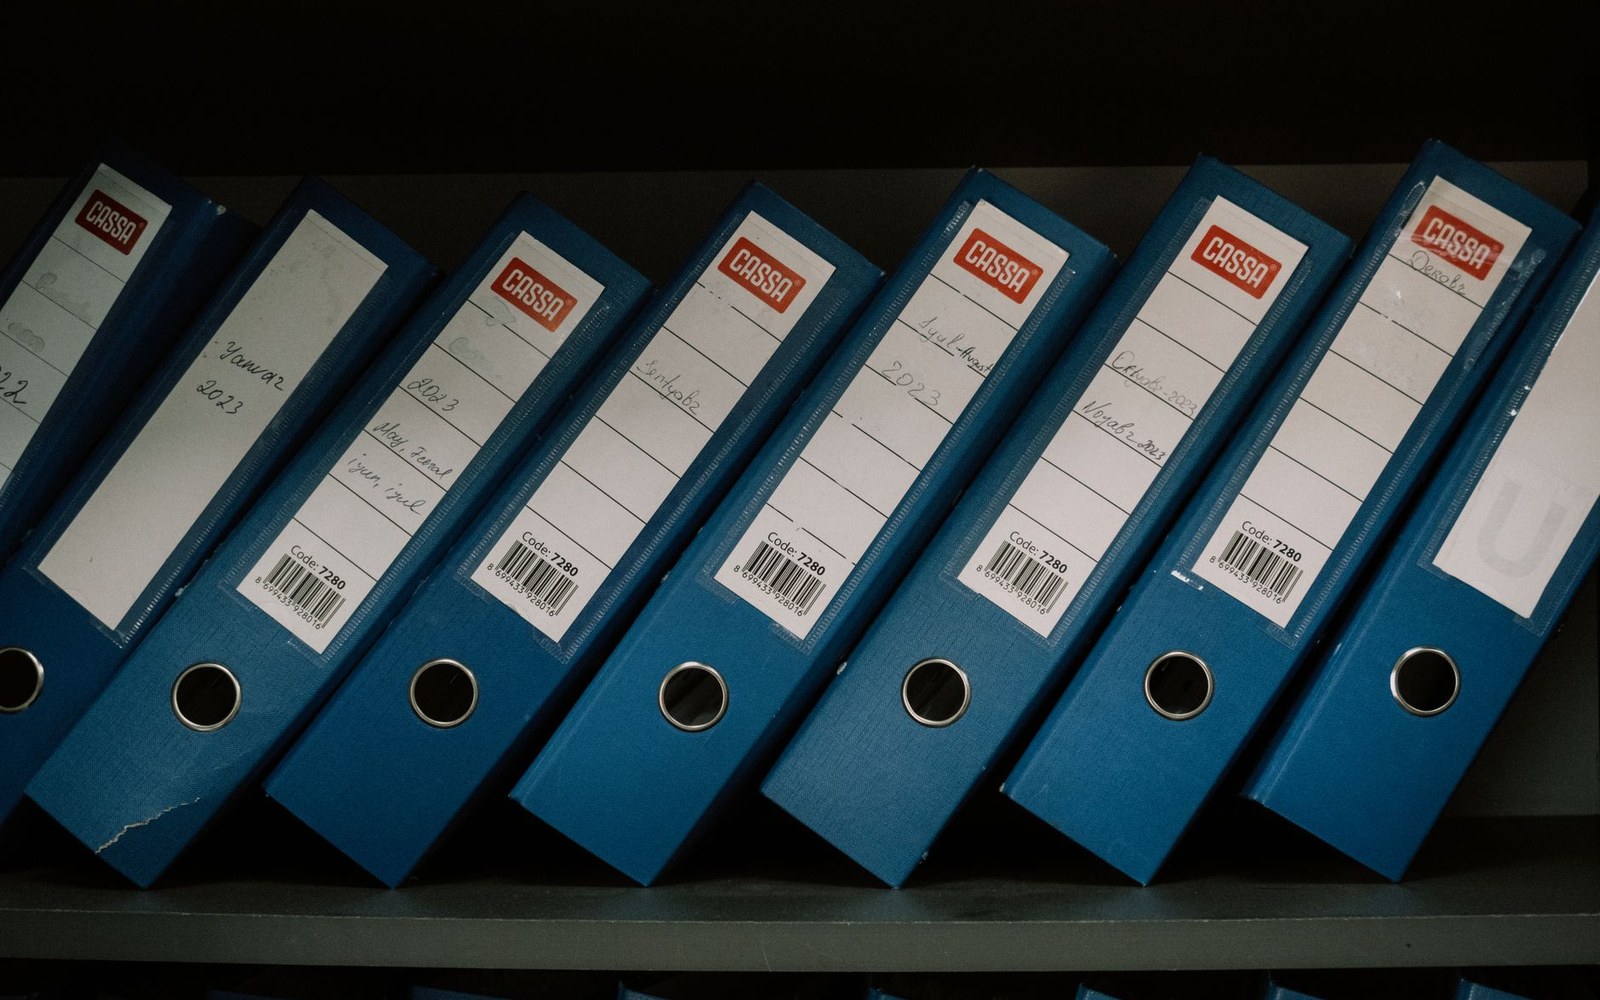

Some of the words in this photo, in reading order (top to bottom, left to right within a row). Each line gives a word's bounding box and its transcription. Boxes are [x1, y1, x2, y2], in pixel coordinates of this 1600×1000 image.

[86, 201, 136, 245] CASSA
[1423, 217, 1490, 270] CASSA
[730, 249, 793, 302] CASSA
[965, 240, 1030, 293] CASSA
[1203, 237, 1269, 289] CASSA
[502, 269, 564, 321] CASSA
[197, 380, 243, 414] 2023
[407, 378, 459, 411] 2023
[881, 361, 941, 406] 2023
[522, 531, 551, 557] Code:
[551, 552, 578, 577] 7280
[767, 532, 797, 557] Code:
[797, 552, 826, 576] 7280
[1009, 531, 1039, 556] Code:
[1039, 550, 1068, 574] 7280
[1242, 521, 1272, 545] Code:
[1272, 539, 1302, 562] 7280
[291, 545, 319, 571] Code:
[318, 566, 346, 590] 7280
